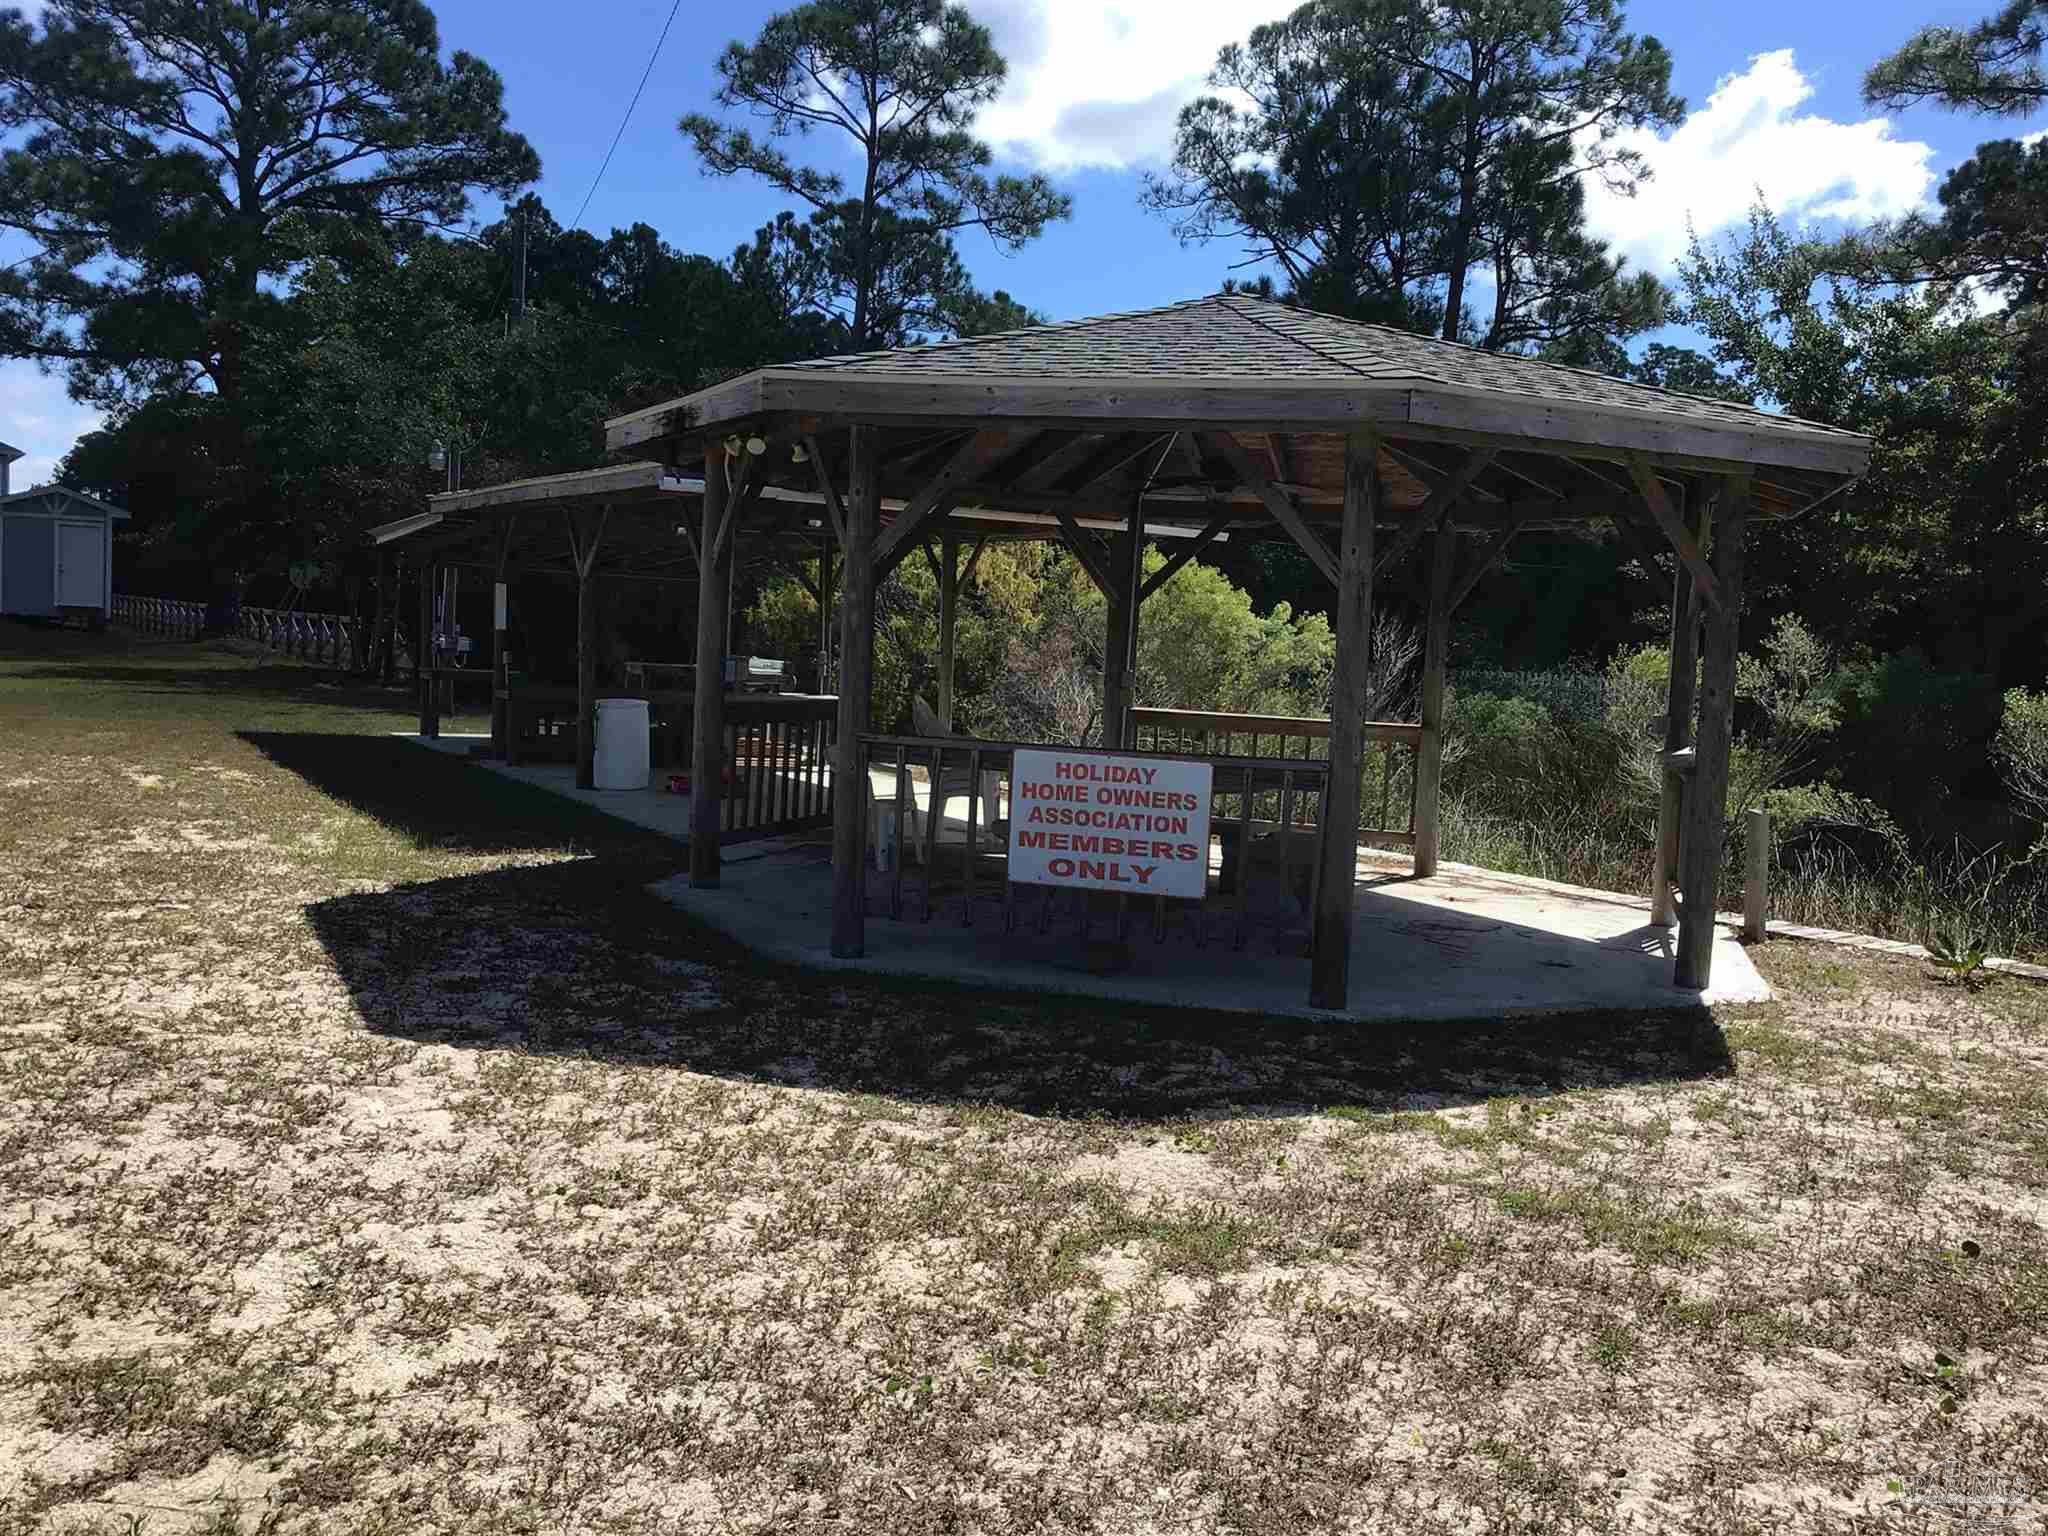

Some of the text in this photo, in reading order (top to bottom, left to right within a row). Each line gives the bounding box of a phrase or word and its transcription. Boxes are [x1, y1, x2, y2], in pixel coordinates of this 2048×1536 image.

[1055, 762, 1158, 785] HOLIDAY
[1021, 782, 1198, 811] HOME OWNERS
[1027, 806, 1188, 834] ASSOCIATION
[1018, 830, 1200, 861] MEMBERS
[1048, 858, 1158, 884] ONLY
